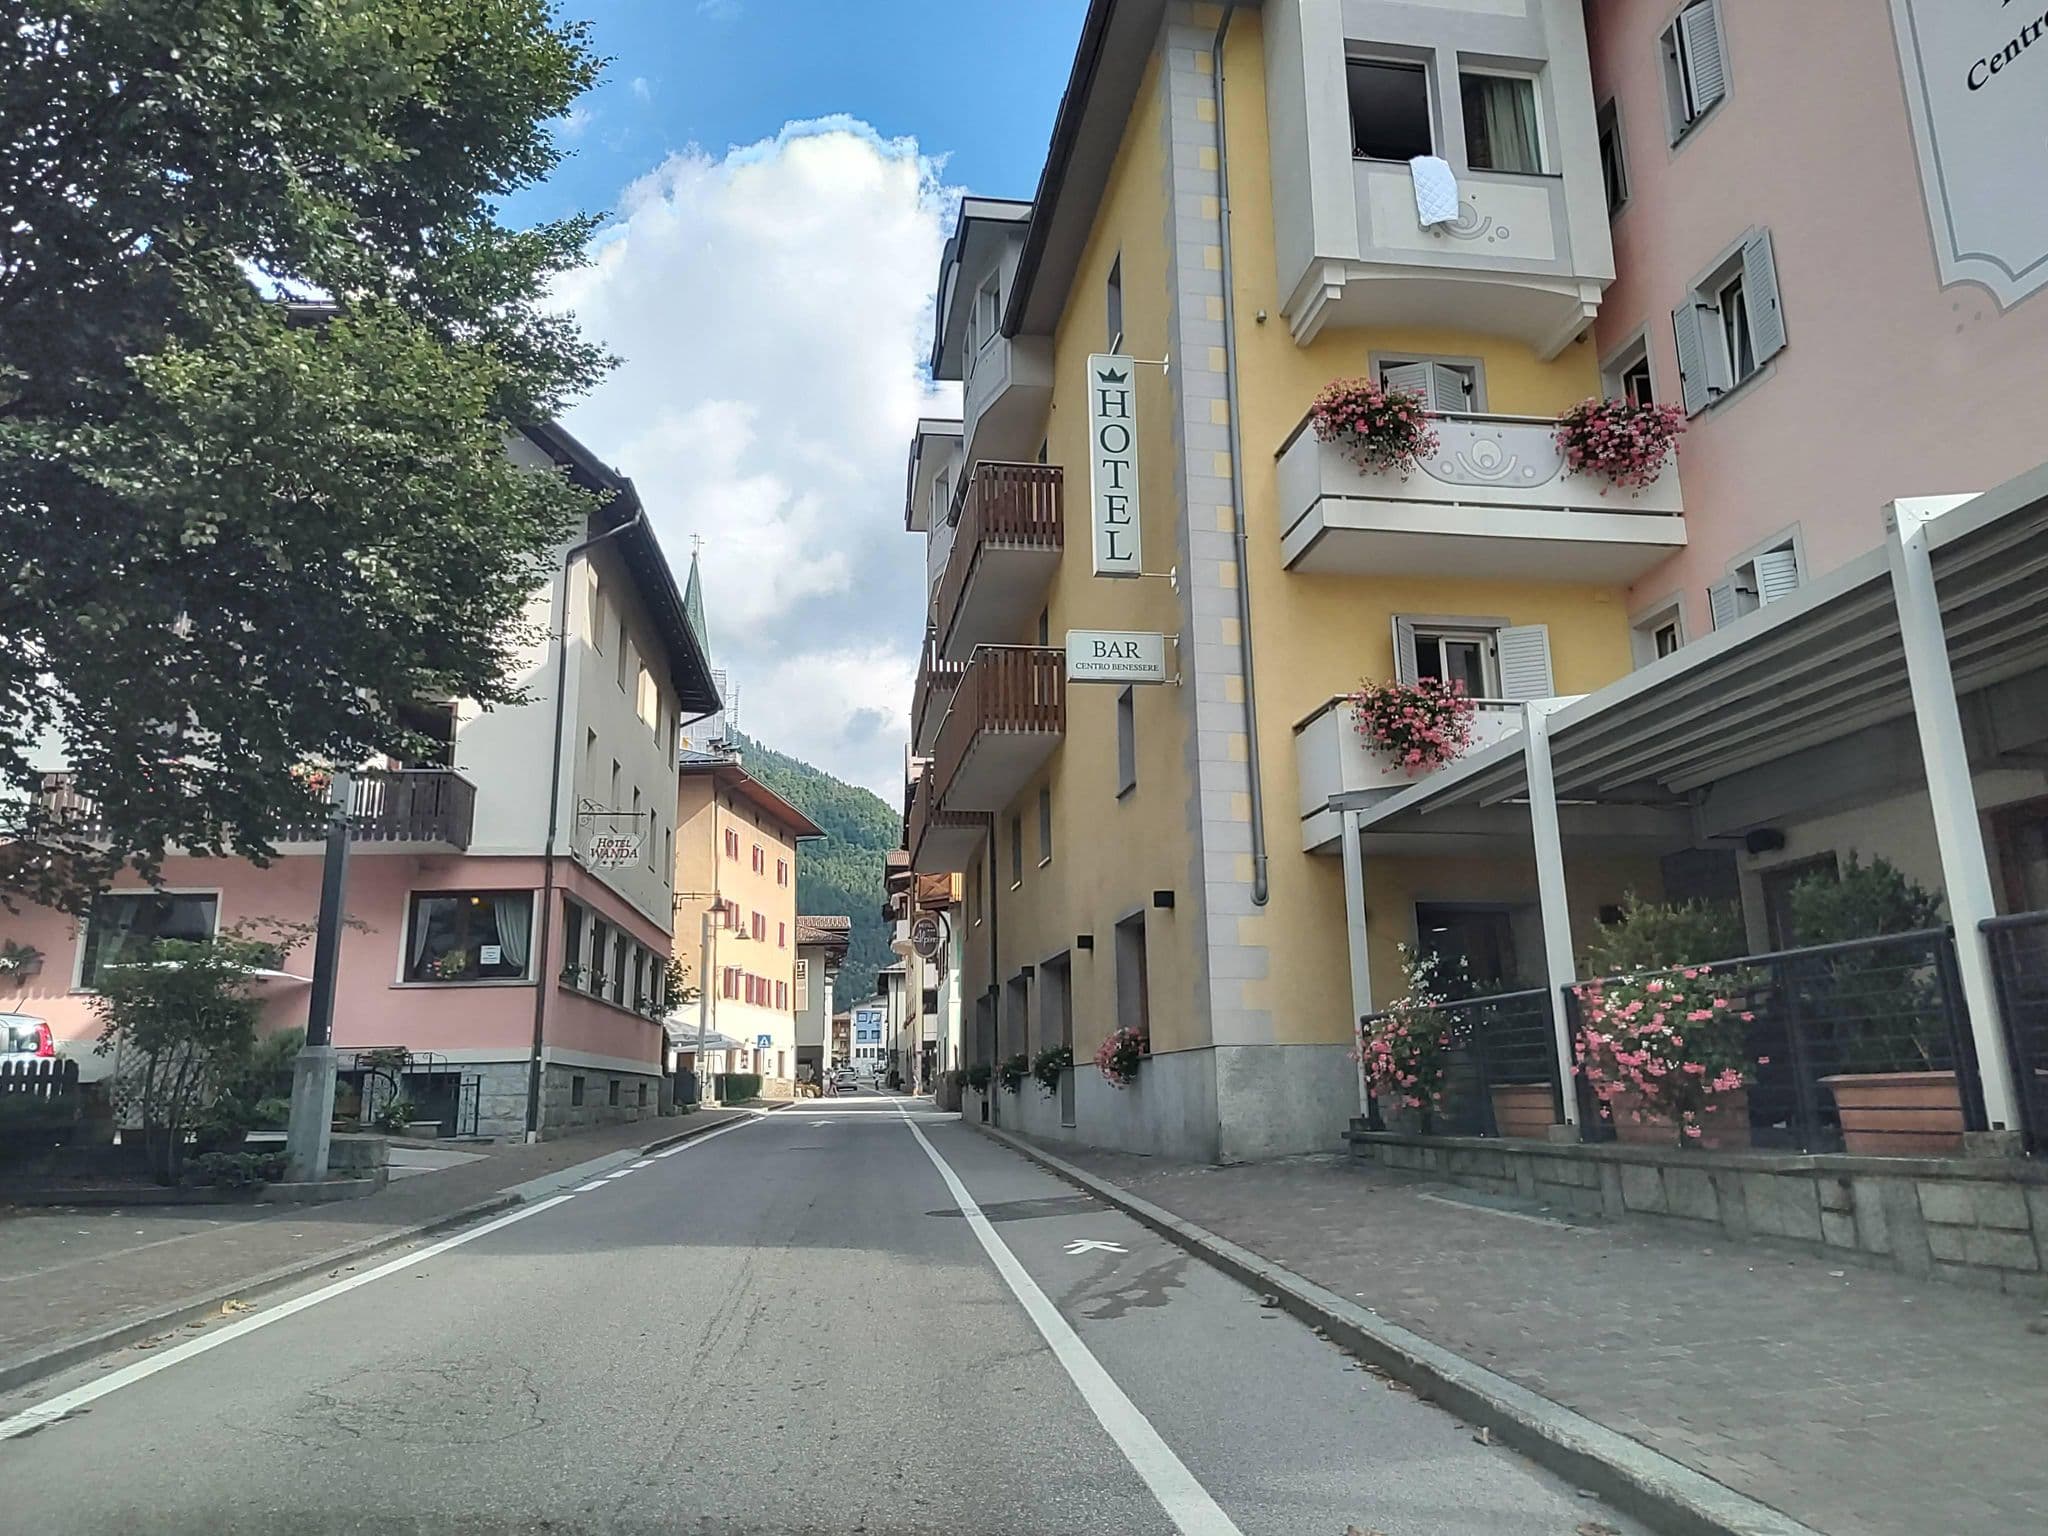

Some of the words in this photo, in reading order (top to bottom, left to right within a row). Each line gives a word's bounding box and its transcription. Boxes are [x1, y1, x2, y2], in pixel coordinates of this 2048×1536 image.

[1097, 388, 1132, 561] HOTEL
[1092, 640, 1142, 659] BAR
[1075, 662, 1111, 671] CENTRO
[1111, 663, 1160, 672] BENESSERE
[597, 837, 632, 848] HOTEL
[590, 848, 639, 858] WANDA
